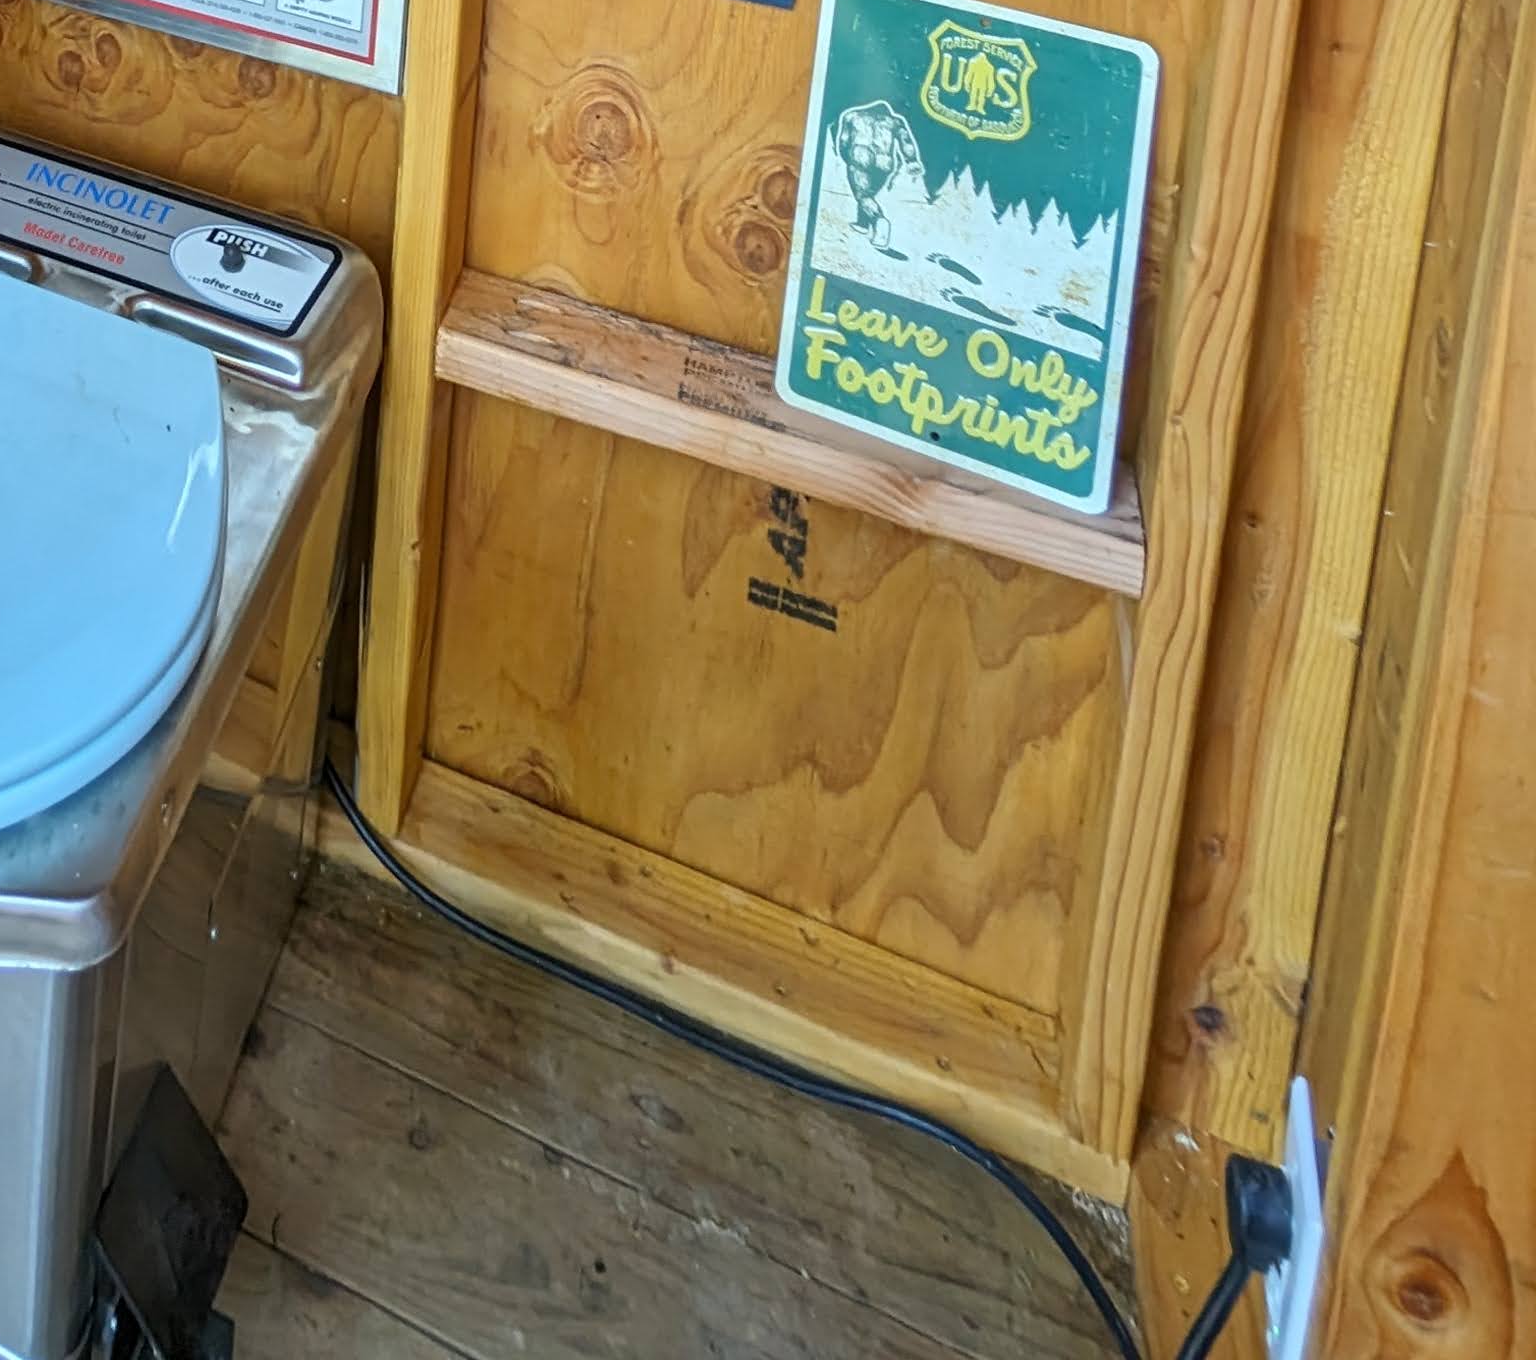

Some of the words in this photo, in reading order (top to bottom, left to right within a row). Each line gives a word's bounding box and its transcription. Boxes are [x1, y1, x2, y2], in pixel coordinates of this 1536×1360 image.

[940, 36, 981, 50] FOREST
[982, 42, 1024, 72] SERVICE
[25, 161, 176, 225] INCINOLET
[27, 196, 61, 213] electric
[62, 206, 119, 234] incinerating
[121, 227, 146, 241] toilet
[23, 222, 66, 244] Model
[68, 235, 126, 265] Carefree
[232, 285, 262, 302] each
[263, 296, 284, 310] use
[805, 273, 949, 358] Leave
[965, 328, 1099, 425] Only
[805, 326, 1092, 471] Footprints
